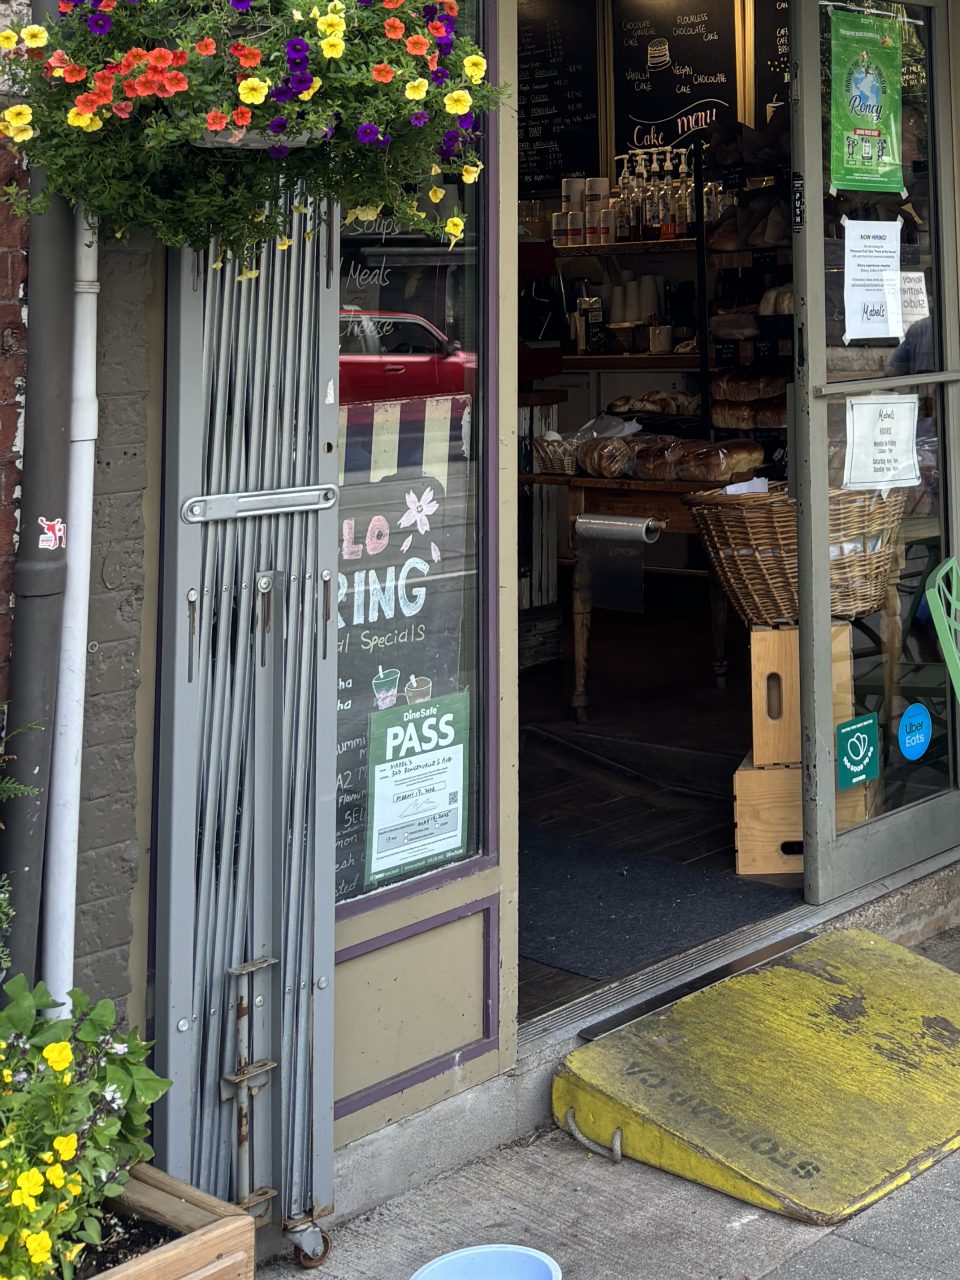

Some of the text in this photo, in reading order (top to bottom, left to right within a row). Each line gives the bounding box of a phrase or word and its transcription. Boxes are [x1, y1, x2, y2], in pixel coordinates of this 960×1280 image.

[677, 12, 708, 24] FLOURLESS
[671, 61, 693, 79] VEGAN
[692, 72, 728, 84] CHOCOLATE
[675, 84, 692, 94] CAKE
[849, 94, 882, 121] Roncy
[633, 108, 717, 147] Cake menu
[349, 217, 400, 243] Soups
[346, 255, 392, 290] Meals
[862, 302, 885, 321] Mabel's
[360, 624, 426, 655] Specials
[403, 706, 438, 721] DineSafe
[386, 713, 455, 761] PASS
[905, 721, 924, 735] Uber
[905, 733, 925, 747] Eats
[850, 764, 864, 772] GOOD
